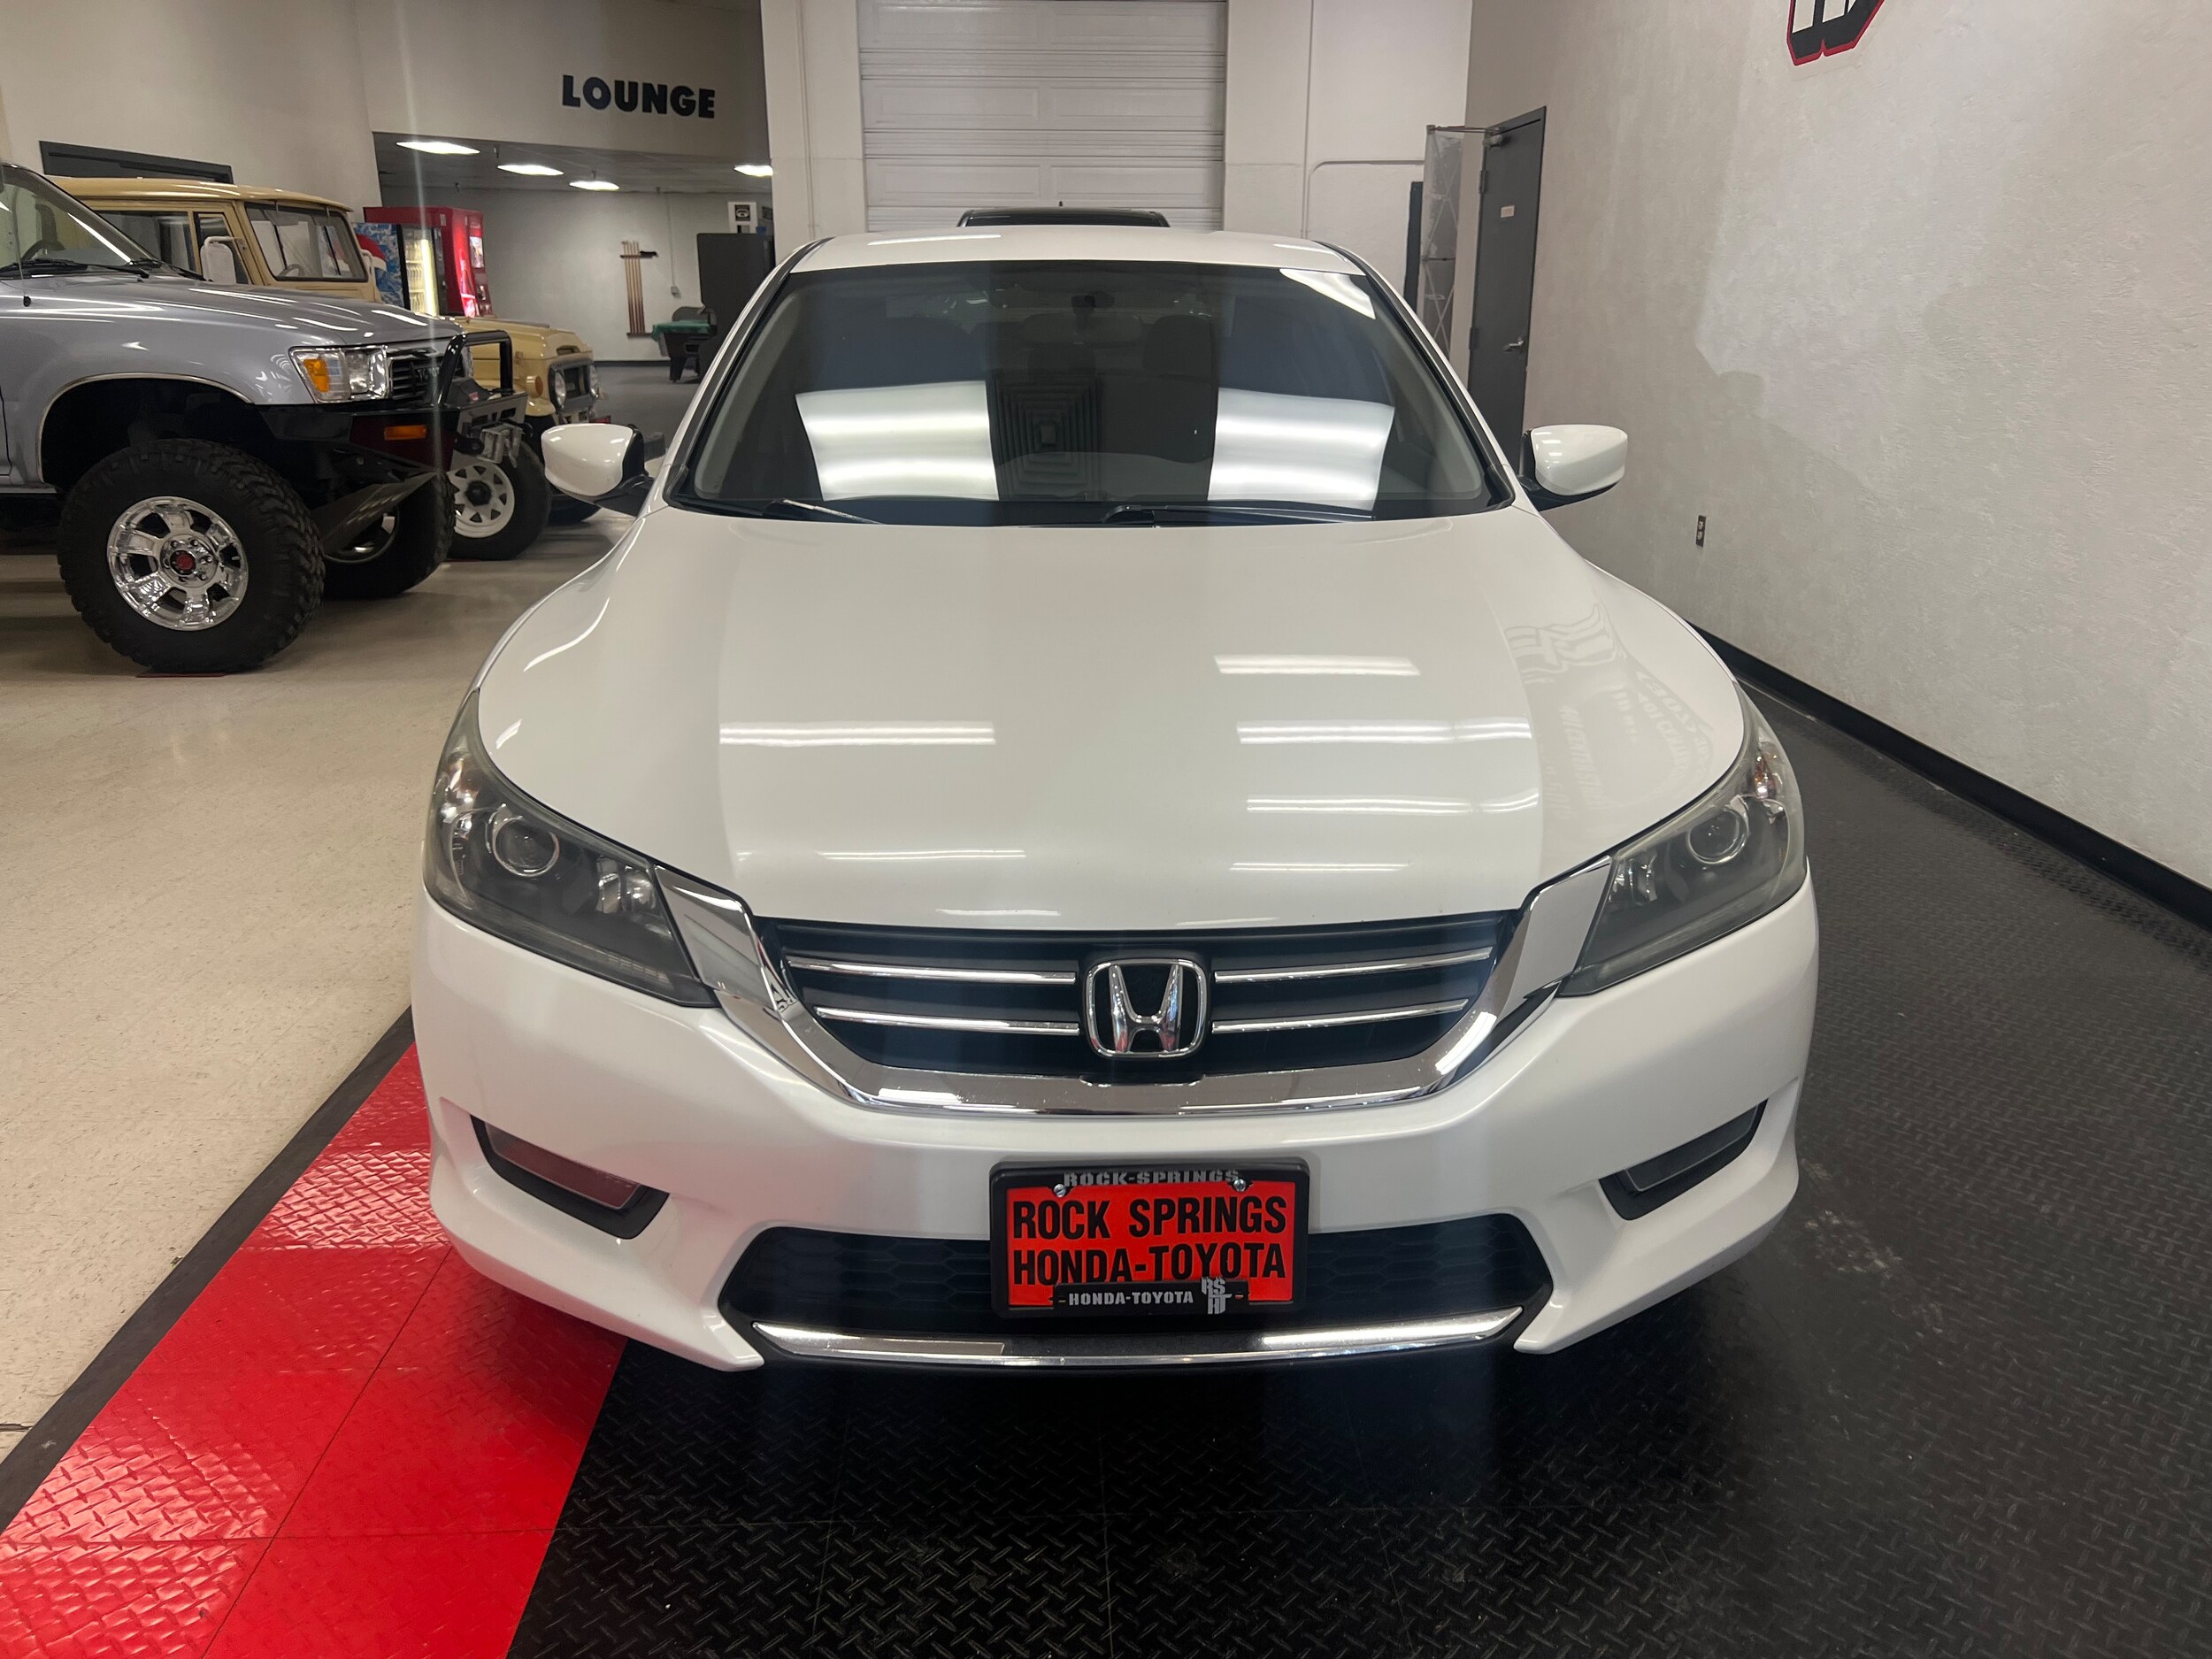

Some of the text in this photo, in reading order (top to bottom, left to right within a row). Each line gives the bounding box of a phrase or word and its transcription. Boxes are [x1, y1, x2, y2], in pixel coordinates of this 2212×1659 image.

[562, 74, 715, 119] LOUNGE
[1064, 1169, 1239, 1187] ROCK-SPRINGS
[1013, 1195, 1286, 1239] ROCK SPRINGS
[1013, 1241, 1286, 1286] HONDA-TOYOTA
[1068, 1291, 1194, 1306] HONDA-TOYOTA
